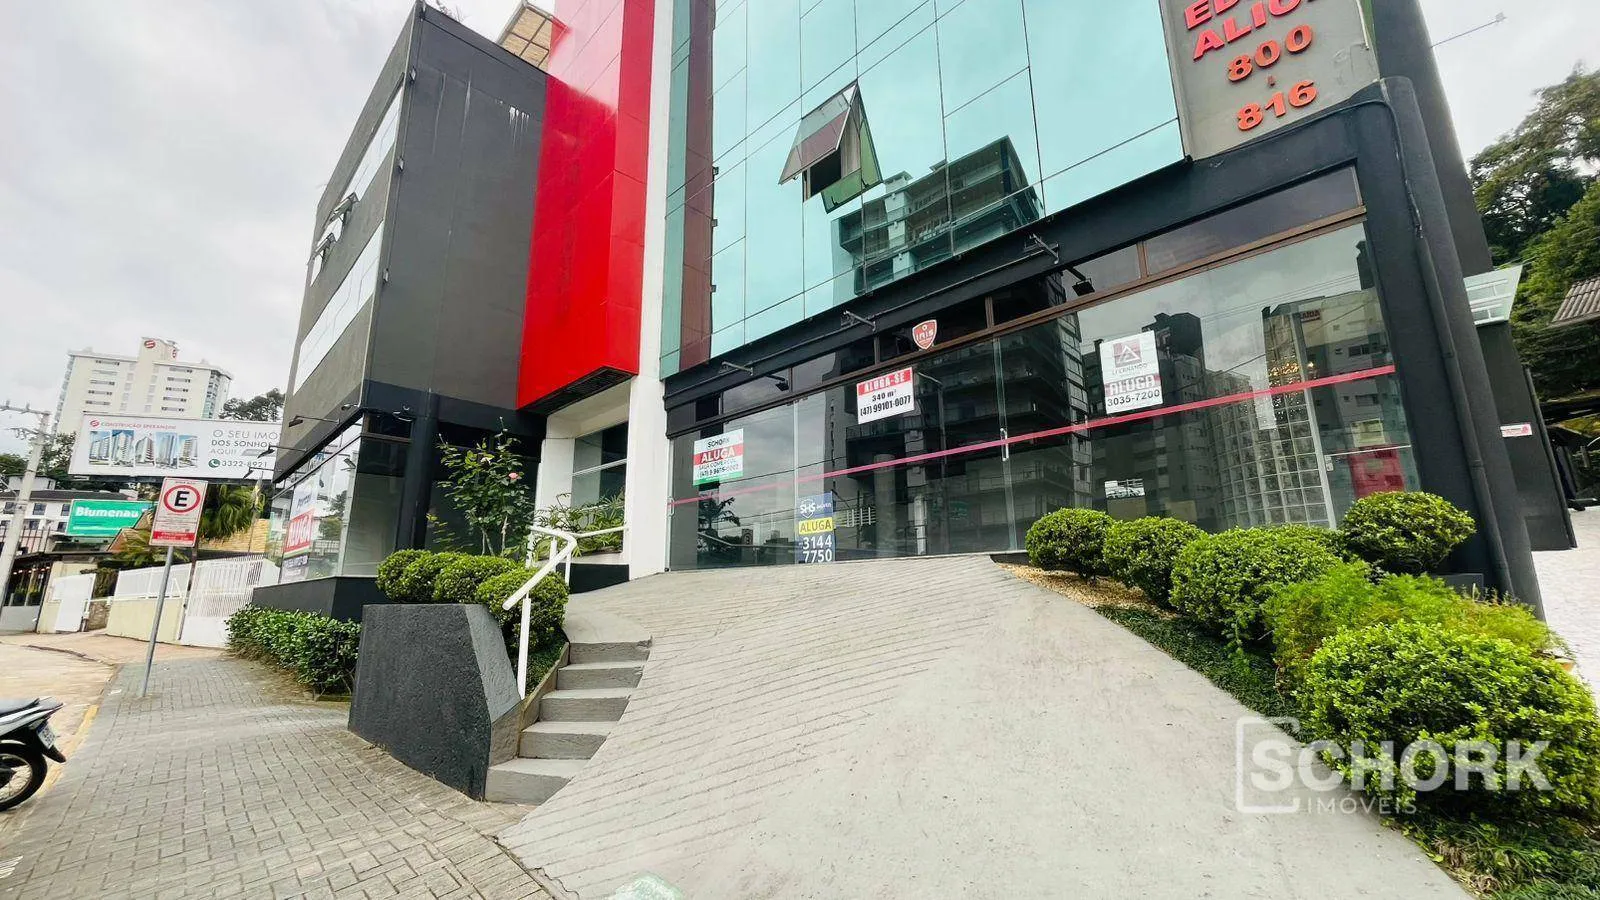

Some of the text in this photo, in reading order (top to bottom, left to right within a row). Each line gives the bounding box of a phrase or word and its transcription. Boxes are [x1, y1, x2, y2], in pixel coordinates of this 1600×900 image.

[1193, 0, 1313, 61] ALIO
[1228, 24, 1313, 82] 800
[1237, 79, 1317, 131] 816
[863, 372, 906, 392] ALUGA-SE
[1110, 375, 1155, 397] ALUGA
[860, 395, 911, 416] (47) 99101-0077
[872, 391, 886, 402] 340
[1107, 388, 1160, 407] 3035-7200
[228, 430, 249, 439] SEU
[700, 446, 735, 464] ALUGA
[174, 490, 190, 507] E
[75, 505, 139, 518] Blumenau
[800, 519, 832, 533] ALUGA
[803, 534, 832, 550] 3144
[803, 548, 832, 564] 7750
